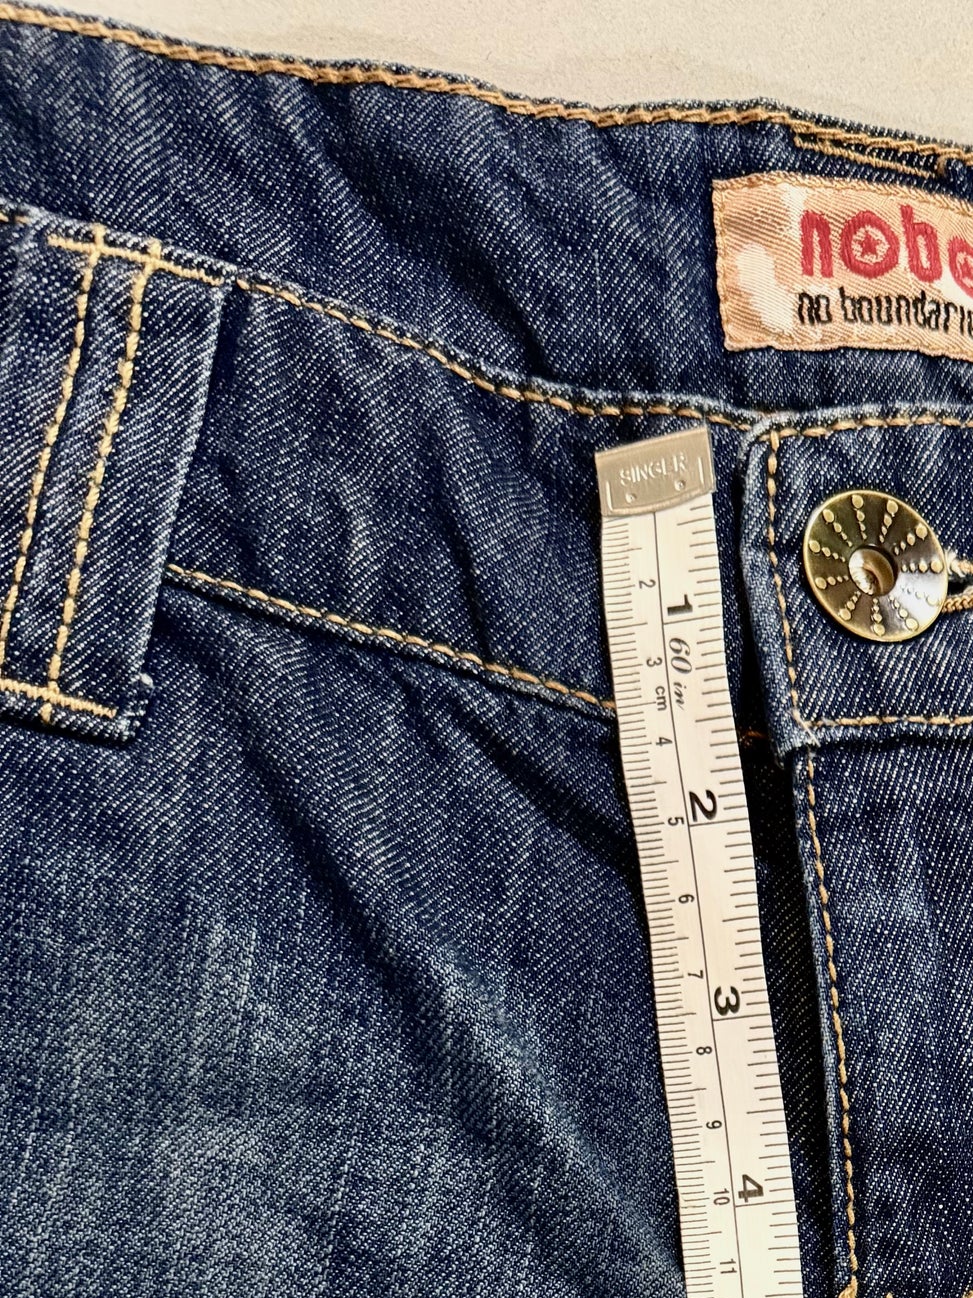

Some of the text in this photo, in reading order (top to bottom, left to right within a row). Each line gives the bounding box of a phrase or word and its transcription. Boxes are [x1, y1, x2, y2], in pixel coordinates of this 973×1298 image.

[797, 291, 832, 326] no
[619, 451, 689, 487] SINGER
[638, 579, 656, 589] 2
[667, 594, 693, 616] 1
[646, 657, 663, 668] 3
[668, 637, 693, 711] 60 in
[655, 686, 668, 712] cm
[655, 736, 673, 747] 4
[688, 789, 718, 822] 2
[667, 816, 685, 827] 5
[678, 894, 695, 905] 6
[687, 969, 704, 979] 7
[714, 985, 740, 1016] 3
[696, 1046, 713, 1056] 8
[705, 1120, 722, 1130] 9
[713, 1187, 730, 1207] 10
[738, 1174, 764, 1203] 4
[719, 1258, 737, 1275] 11
